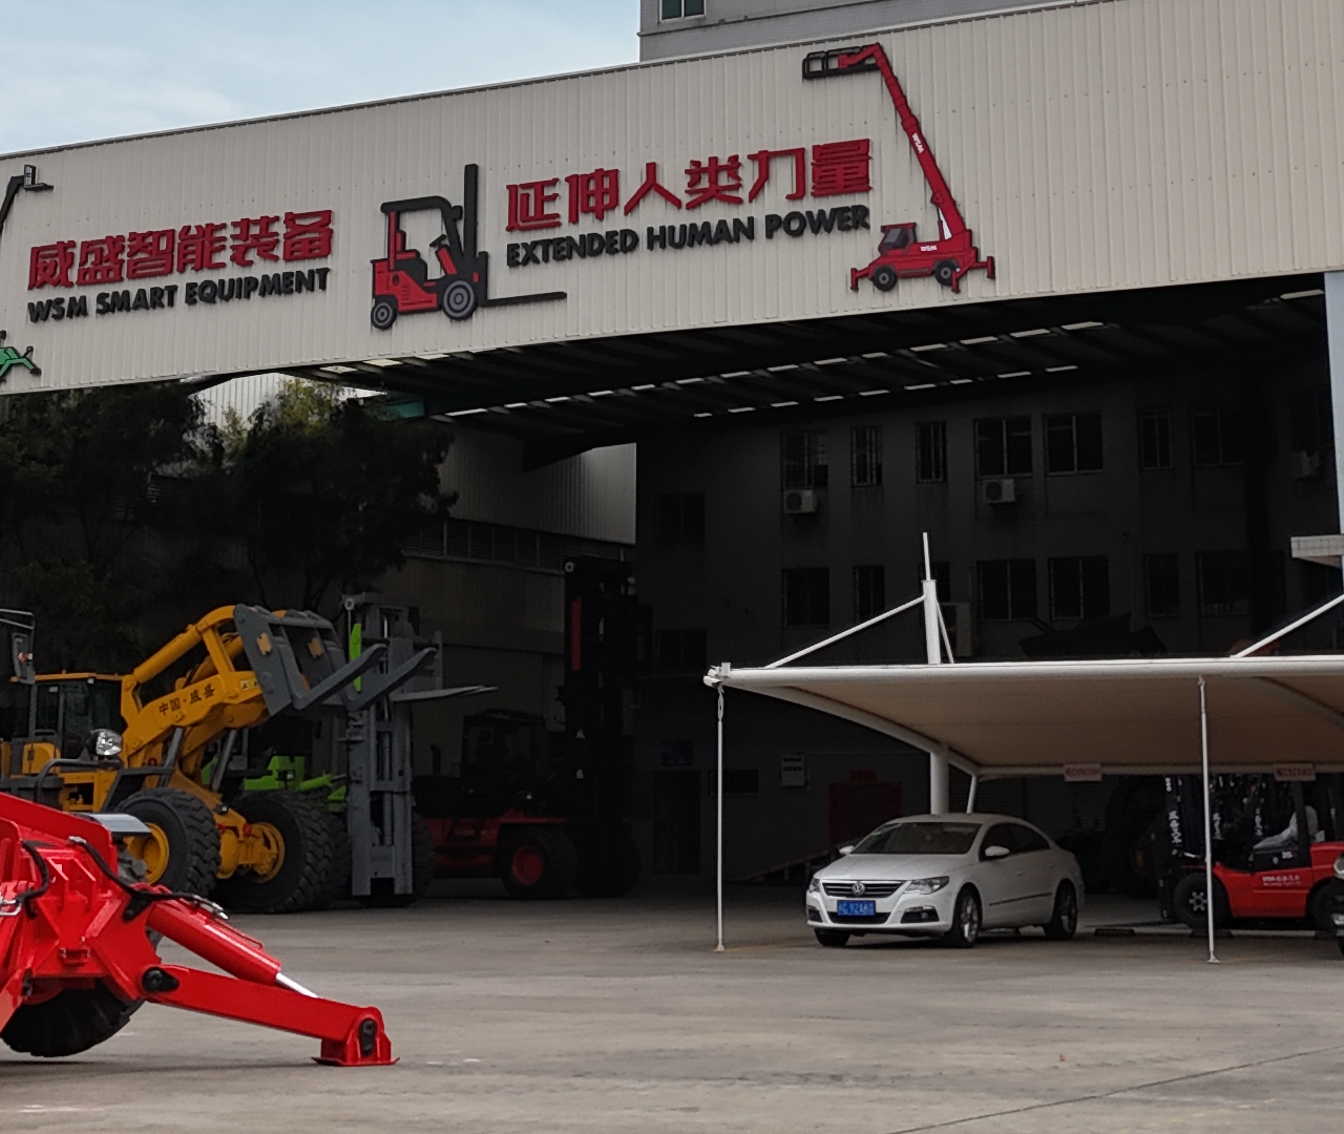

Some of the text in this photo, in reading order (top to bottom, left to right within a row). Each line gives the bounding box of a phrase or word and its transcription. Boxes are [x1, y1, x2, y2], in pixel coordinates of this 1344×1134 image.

[505, 137, 873, 232] 延伸人类力量
[26, 209, 334, 291] 威盛智能装备
[506, 204, 871, 268] EXTENDED HUMAN POWER
[27, 267, 331, 323] WSM SMART EQUIPMENT
